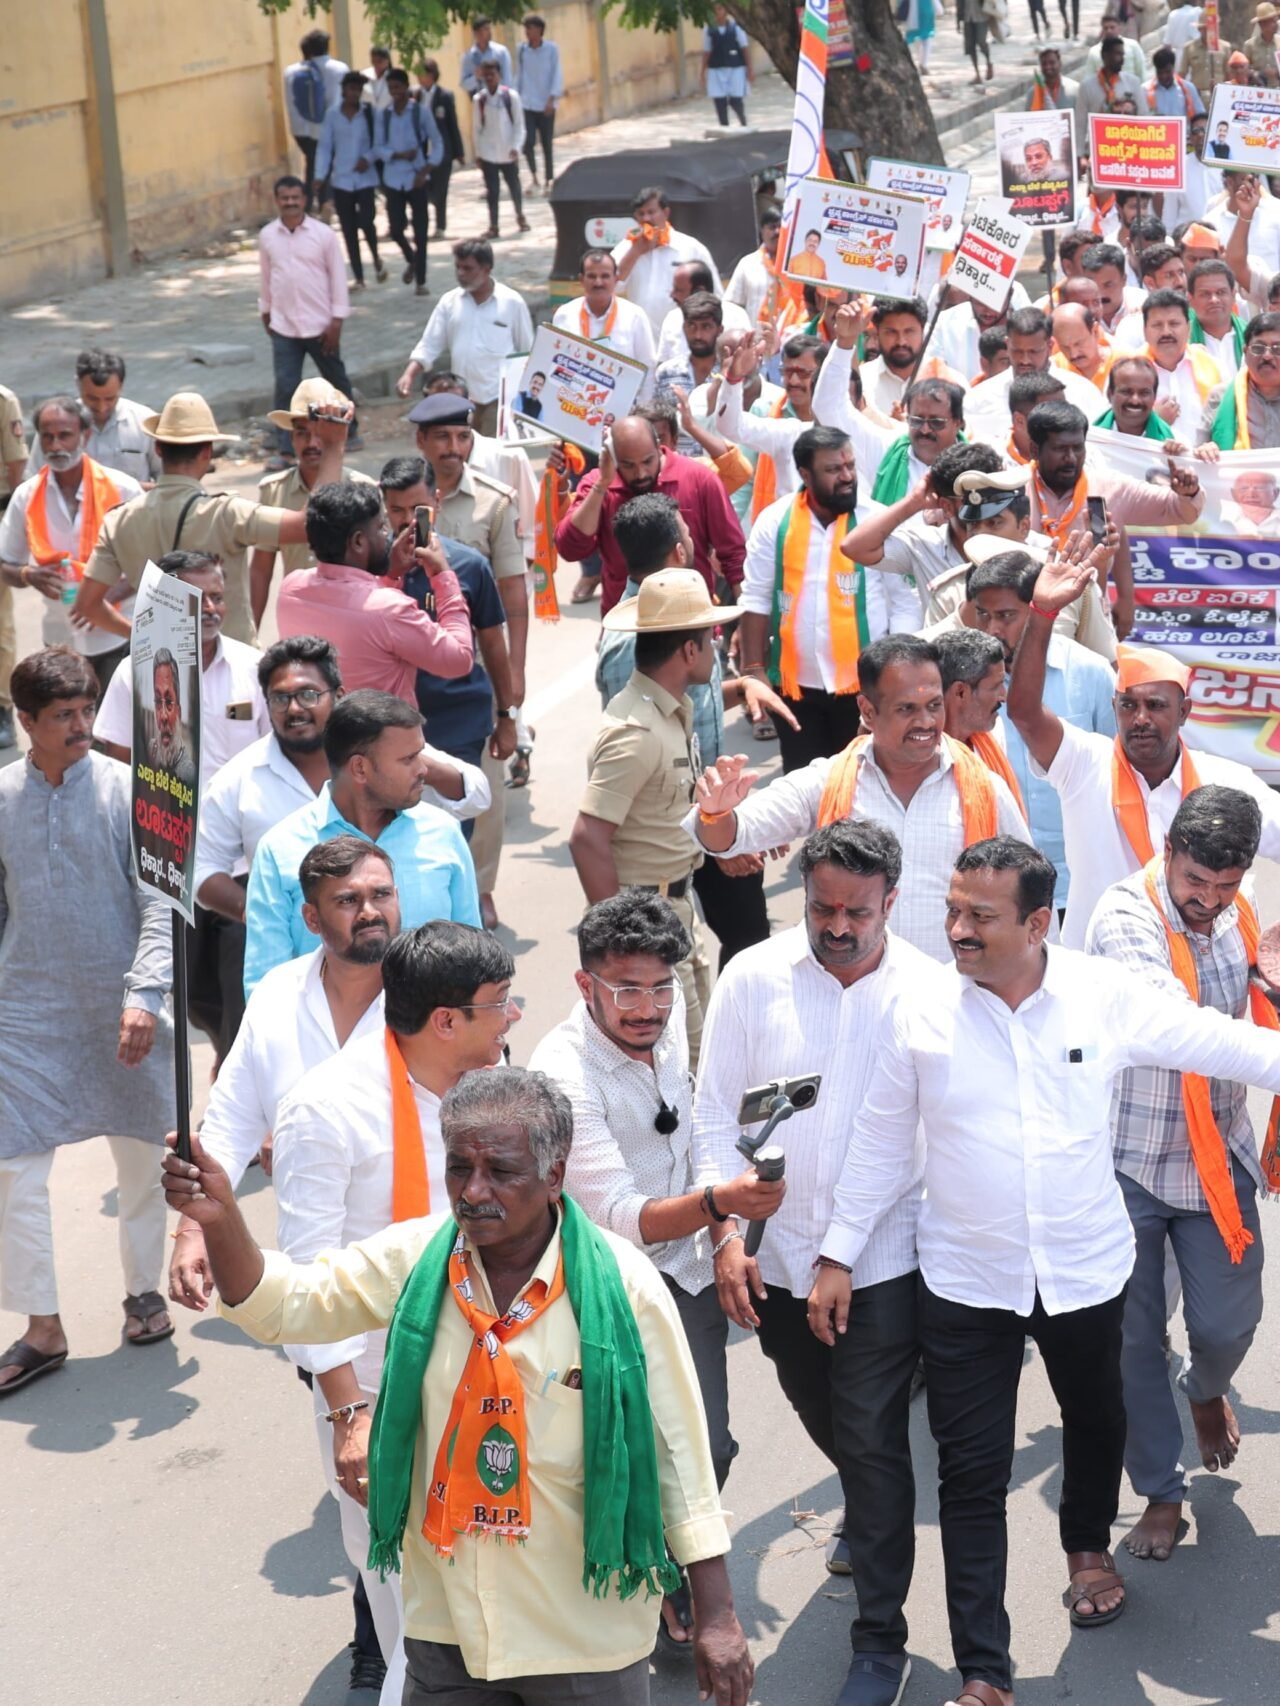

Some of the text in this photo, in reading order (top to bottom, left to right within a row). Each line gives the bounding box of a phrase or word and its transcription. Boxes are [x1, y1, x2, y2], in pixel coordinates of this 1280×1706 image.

[1098, 142, 1138, 162] ಕಾಂಗ್ರೆಸ್
[1152, 588, 1270, 605] ಬೆಲೆ ಏರಿಕೆ
[1143, 629, 1192, 643] ಹಣ
[1200, 629, 1268, 644] ಲೂಟಿ
[156, 769, 169, 792] ಬೆಲೆ
[135, 798, 193, 864] ಲೂಟಪ್ಪಗೆ
[473, 1505, 523, 1525] B.J.P.
